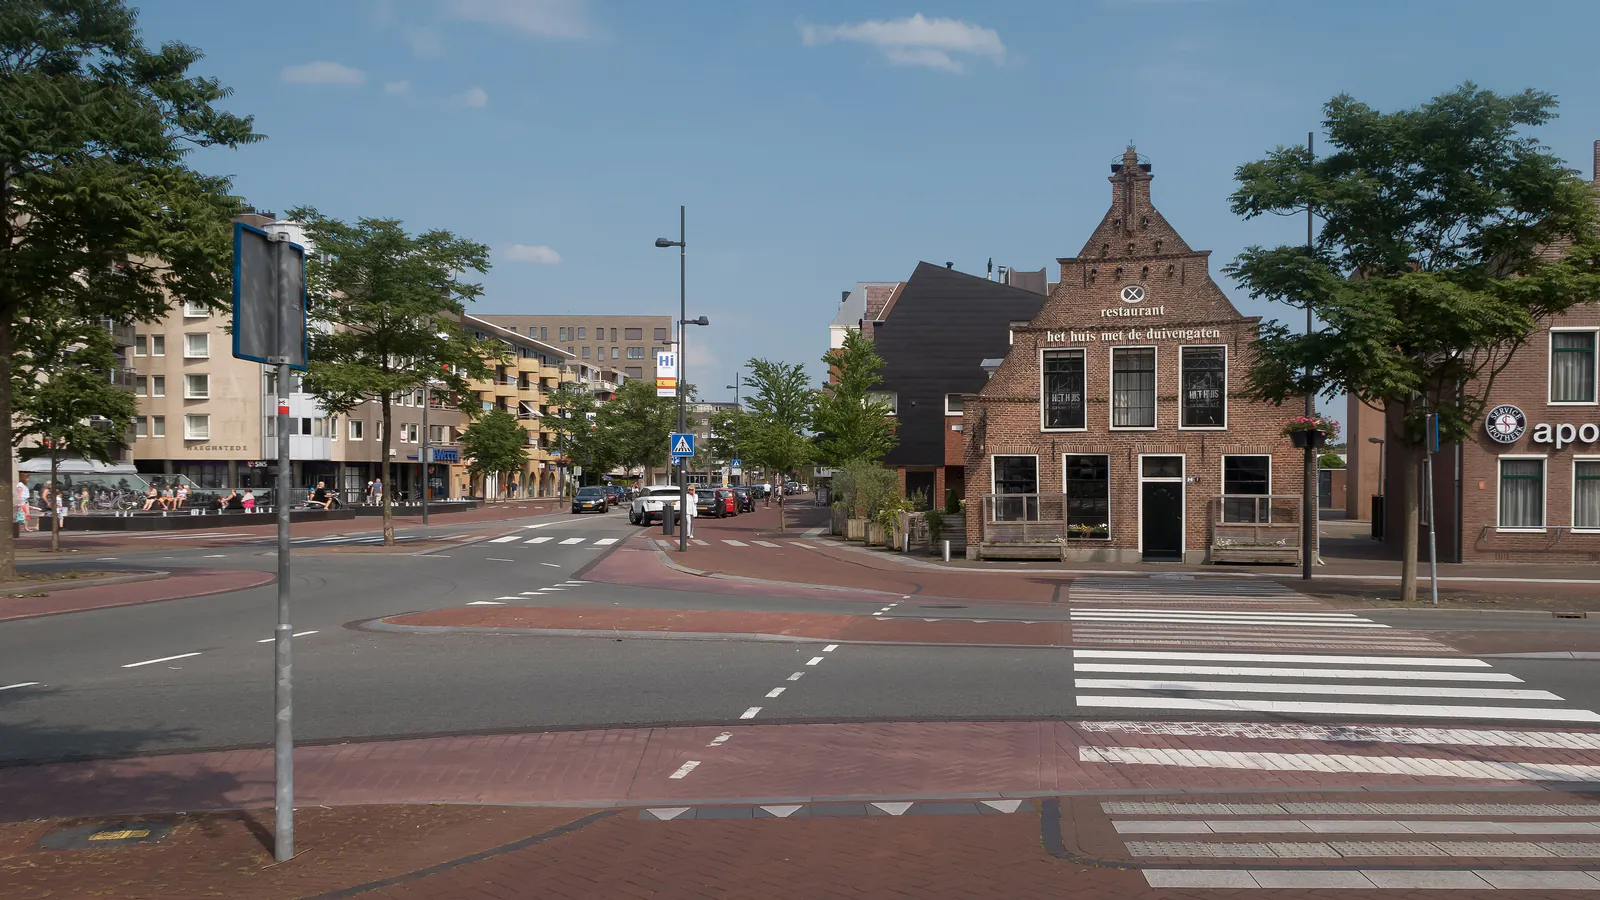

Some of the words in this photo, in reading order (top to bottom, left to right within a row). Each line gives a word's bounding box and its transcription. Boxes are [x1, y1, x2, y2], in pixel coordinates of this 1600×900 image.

[1101, 305, 1164, 317] restaurant
[1047, 331, 1065, 342] het
[1070, 331, 1096, 342] huis
[1101, 331, 1122, 341] met
[1128, 329, 1142, 340] de
[1147, 328, 1220, 340] duivengaten
[659, 355, 674, 366] Hi
[1491, 407, 1522, 420] SERVICE
[1488, 425, 1524, 441] APOTHEEK
[1533, 423, 1599, 449] apo
